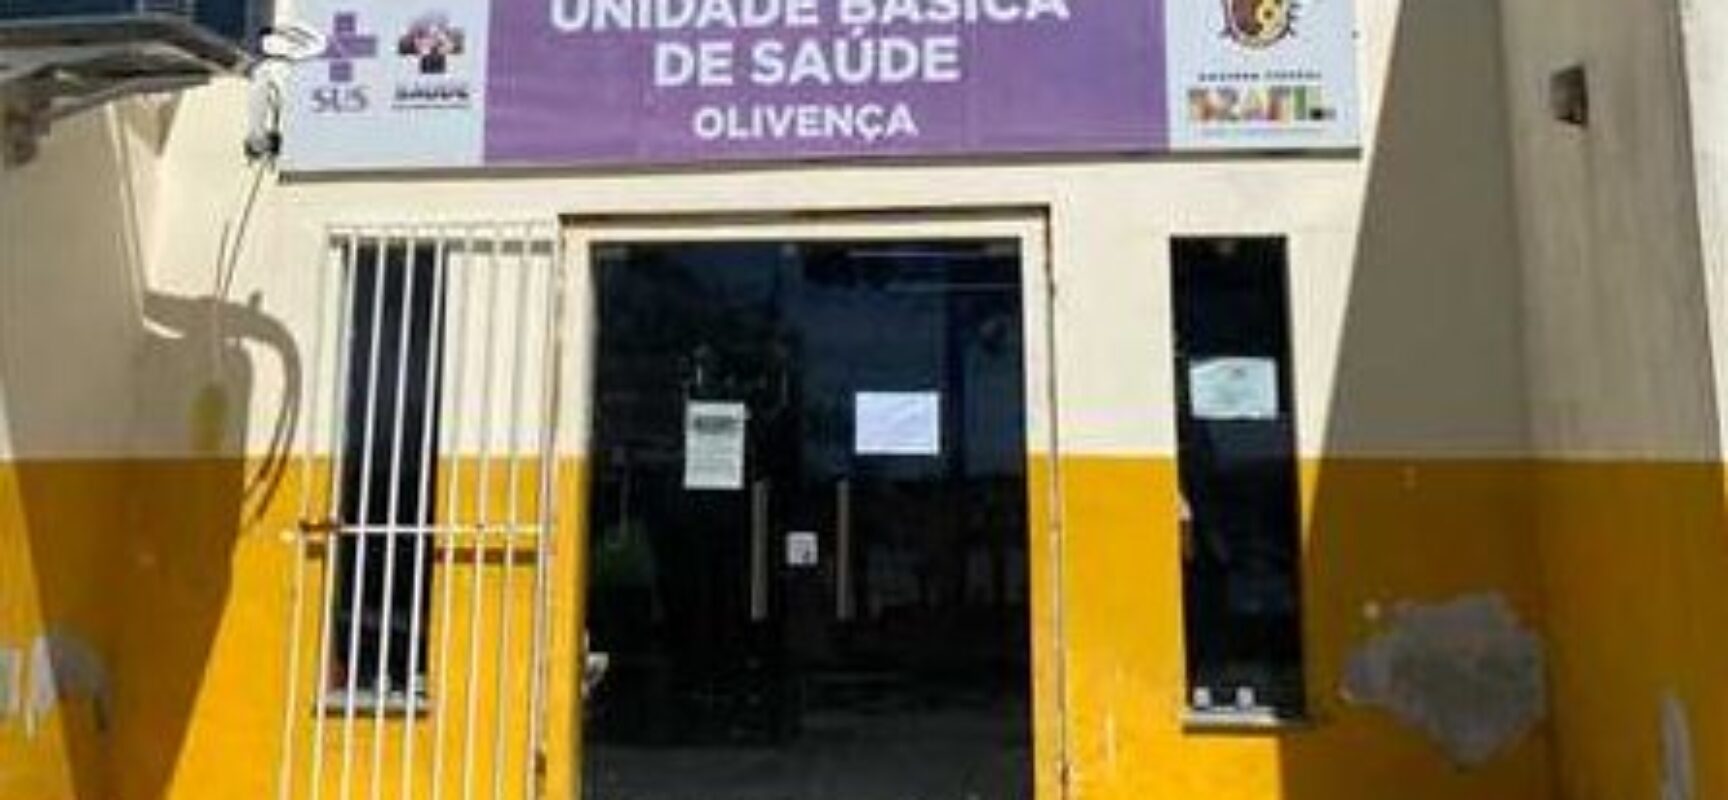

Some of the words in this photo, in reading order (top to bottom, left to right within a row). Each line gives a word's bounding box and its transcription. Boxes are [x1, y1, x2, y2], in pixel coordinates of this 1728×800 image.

[551, 0, 820, 31] UNIDADE
[654, 40, 734, 87] DE
[751, 26, 961, 84] SAÚDE
[311, 85, 371, 113] SUS
[693, 102, 919, 142] OLIVENÇA
